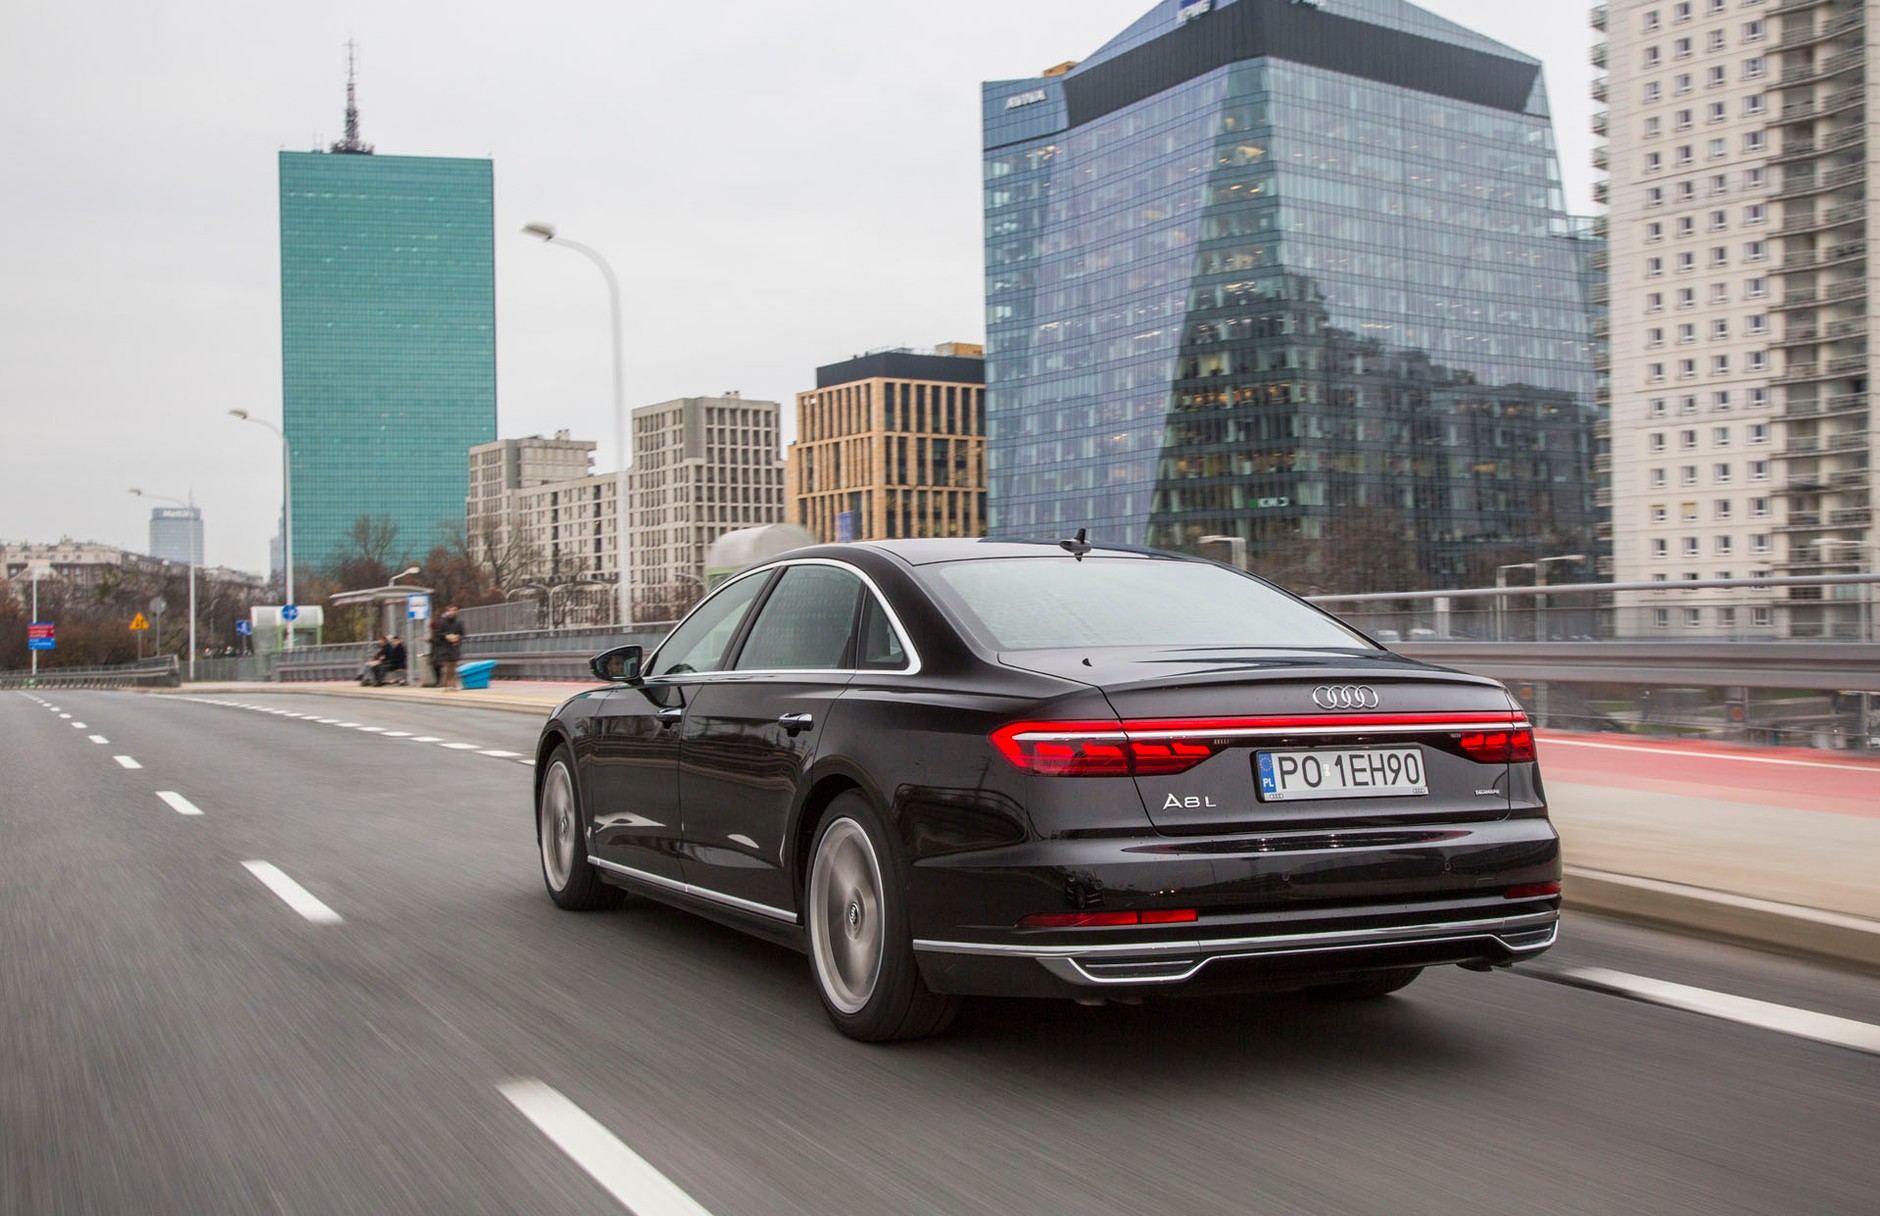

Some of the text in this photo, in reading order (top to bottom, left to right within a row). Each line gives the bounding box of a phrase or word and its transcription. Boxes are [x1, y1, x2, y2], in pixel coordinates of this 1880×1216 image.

[1278, 753, 1420, 789] PO 1EH90
[1263, 778, 1275, 788] PL
[1162, 793, 1217, 810] A8 L
